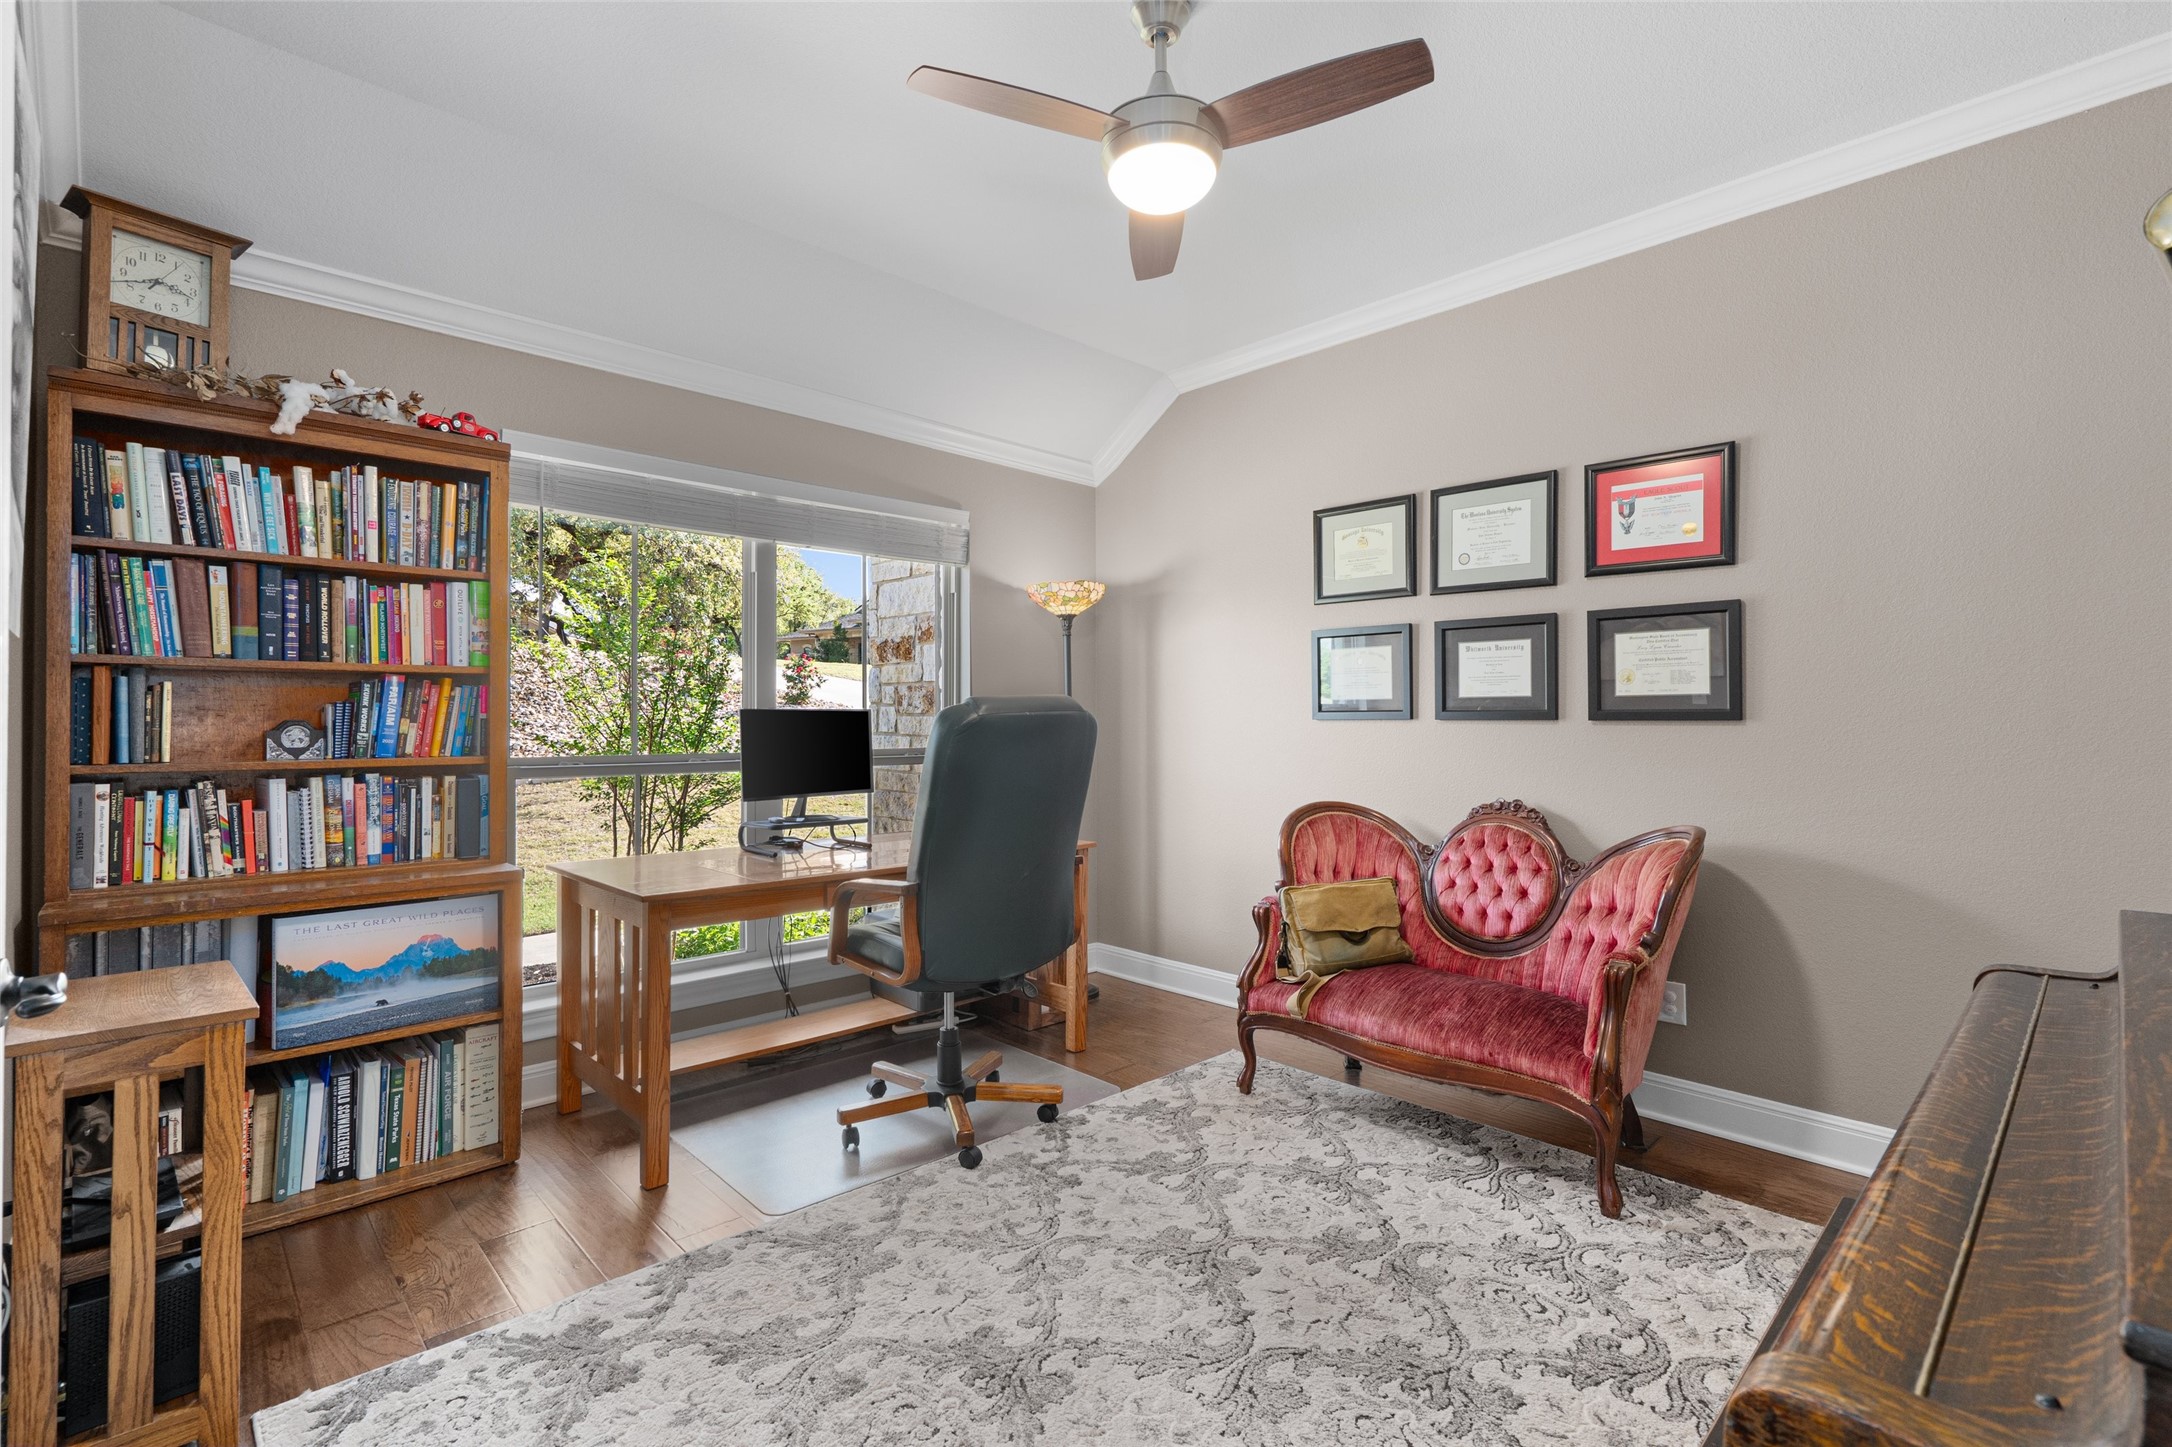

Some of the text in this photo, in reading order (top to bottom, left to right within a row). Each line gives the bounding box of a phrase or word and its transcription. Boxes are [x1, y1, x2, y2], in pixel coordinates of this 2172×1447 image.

[126, 257, 136, 267] 10
[139, 251, 147, 262] 11
[155, 253, 166, 264] 12
[120, 268, 127, 276] 9
[184, 274, 192, 283] 2
[139, 294, 146, 304] 7
[190, 288, 197, 297] 3
[154, 302, 162, 311] 6
[171, 303, 178, 313] 5
[172, 474, 182, 496] LAST
[217, 480, 227, 508] FORAGING
[190, 474, 208, 534] THE TAO OF EQUUS
[264, 492, 272, 505] WHY
[387, 483, 396, 536] ENDURING COURAGE
[176, 499, 187, 521] DAYS
[264, 506, 272, 515] WE
[267, 527, 275, 540] SICK
[402, 522, 412, 549] D-DAY
[149, 605, 158, 641] HORSEMANSHIP
[219, 590, 228, 645] MOUNTAINEERING
[360, 683, 371, 732] SKUNK WORKS
[386, 686, 398, 726] FAR/AIM
[168, 794, 176, 813] DARING
[167, 814, 175, 837] GREATLY
[232, 806, 240, 845] SCOUTMASTER'S
[76, 833, 84, 860] GENERALS
[294, 906, 485, 936] THE LAST GREAT WILD PLACES
[468, 1036, 498, 1045] AIRCRAFT
[337, 1076, 351, 1168] ARNOLD SCHWARZENEGGER
